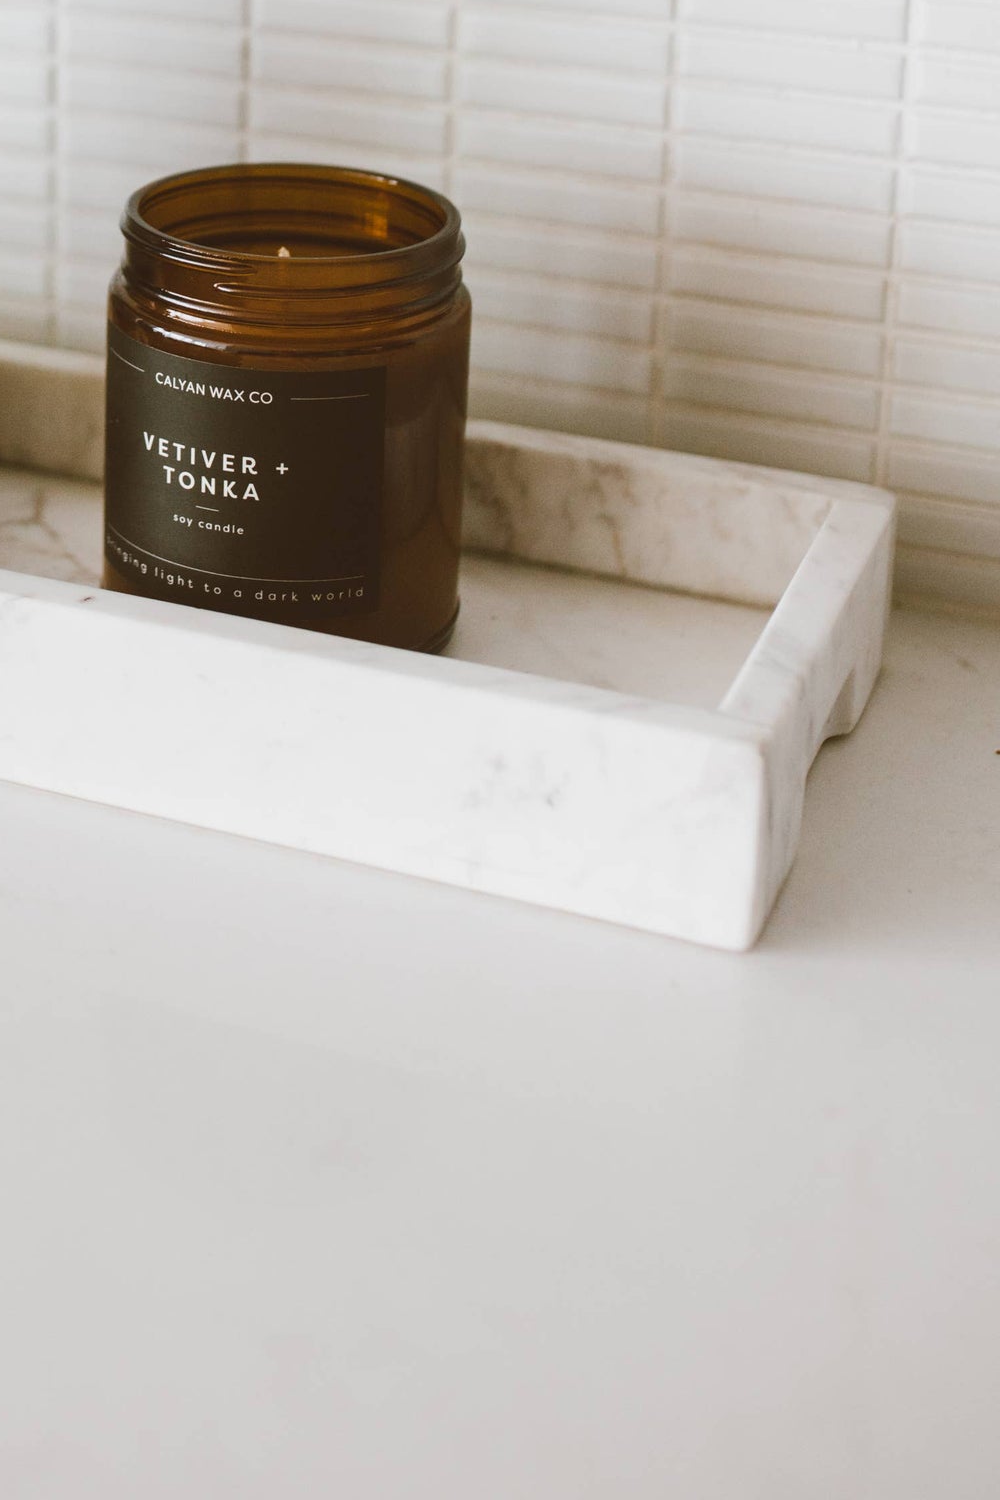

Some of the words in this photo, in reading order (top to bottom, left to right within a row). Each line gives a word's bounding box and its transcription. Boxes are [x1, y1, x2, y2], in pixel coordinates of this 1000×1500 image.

[155, 372, 206, 396] CALYAN
[209, 386, 244, 402] WAX
[249, 391, 273, 404] CO
[143, 431, 258, 474] VETIVER
[162, 465, 260, 501] TONKA
[172, 514, 194, 527] soy
[198, 520, 244, 535] candle
[154, 566, 194, 589] light
[204, 582, 222, 596] to
[233, 588, 242, 598] a
[254, 586, 299, 602] dark
[312, 586, 364, 602] world
